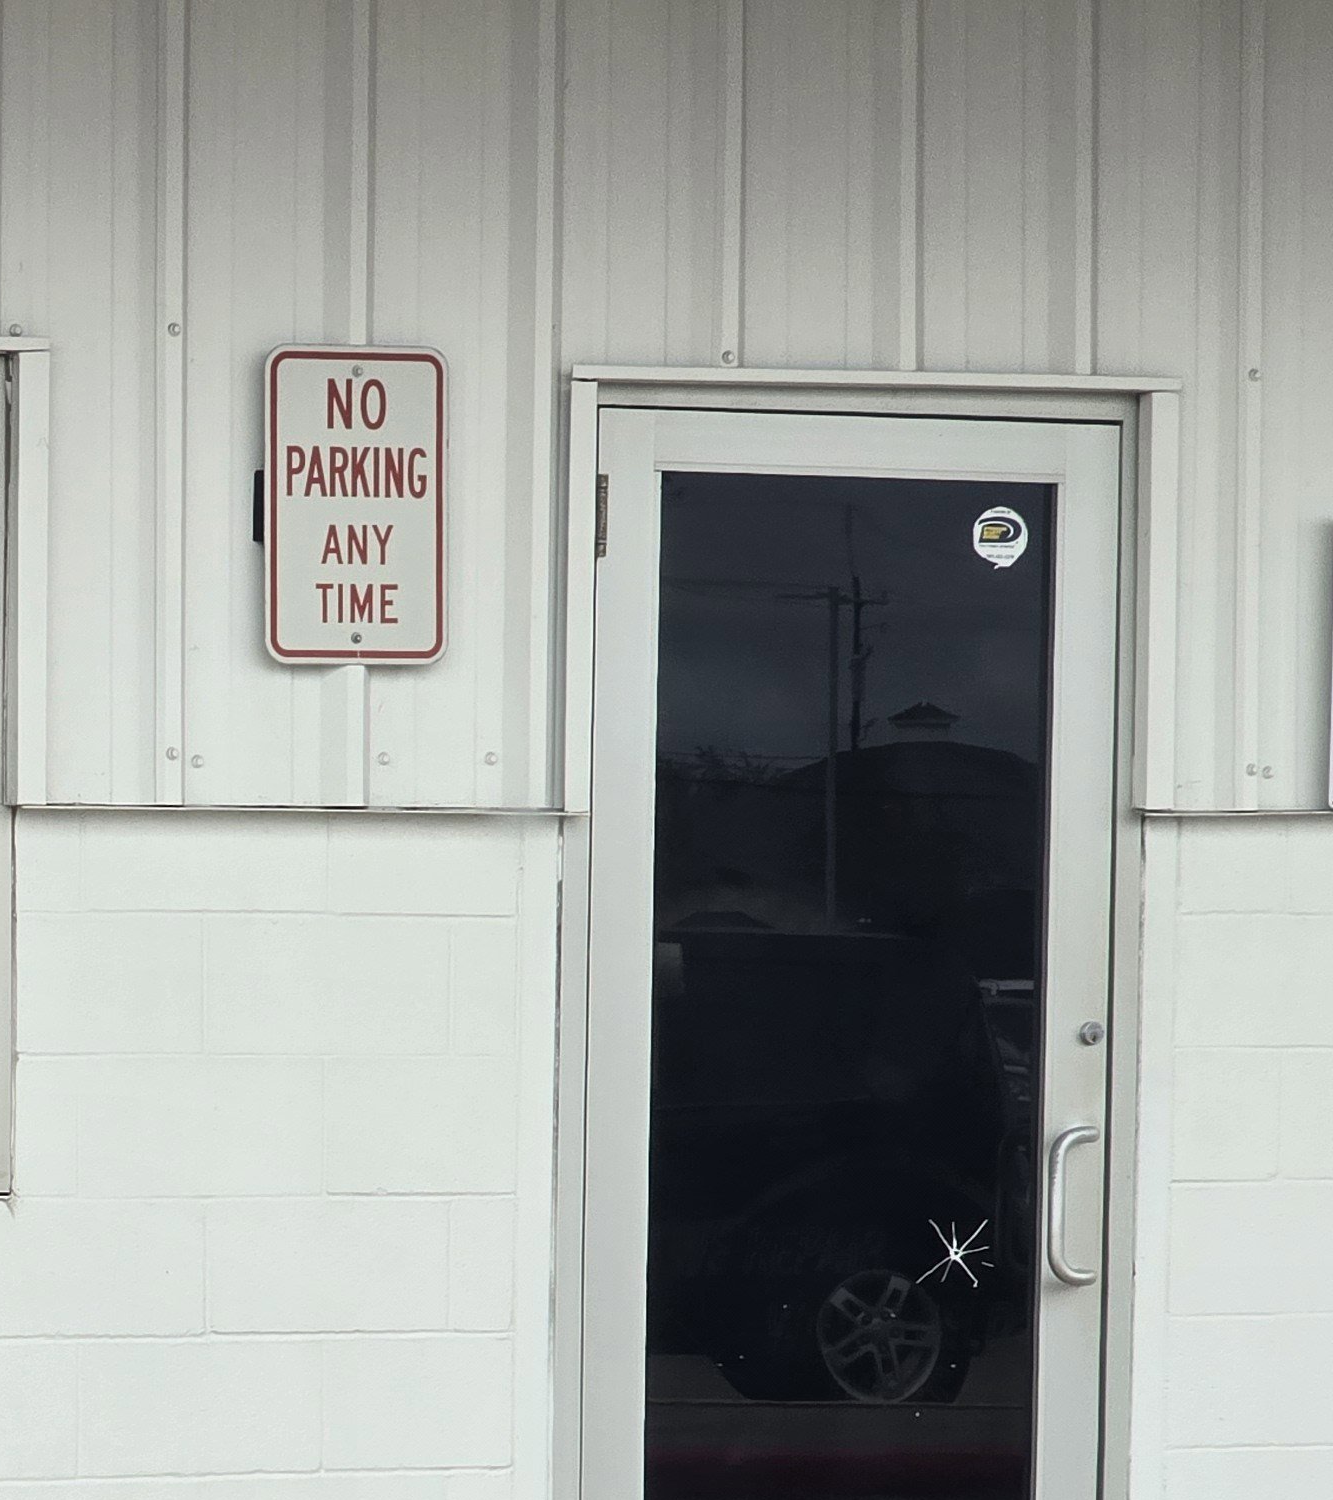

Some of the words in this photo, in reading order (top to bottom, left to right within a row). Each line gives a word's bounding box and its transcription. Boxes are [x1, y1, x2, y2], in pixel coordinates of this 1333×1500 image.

[326, 378, 387, 431] NO
[286, 445, 428, 500] PARKING
[320, 524, 394, 565] ANY
[315, 583, 399, 625] TIME
